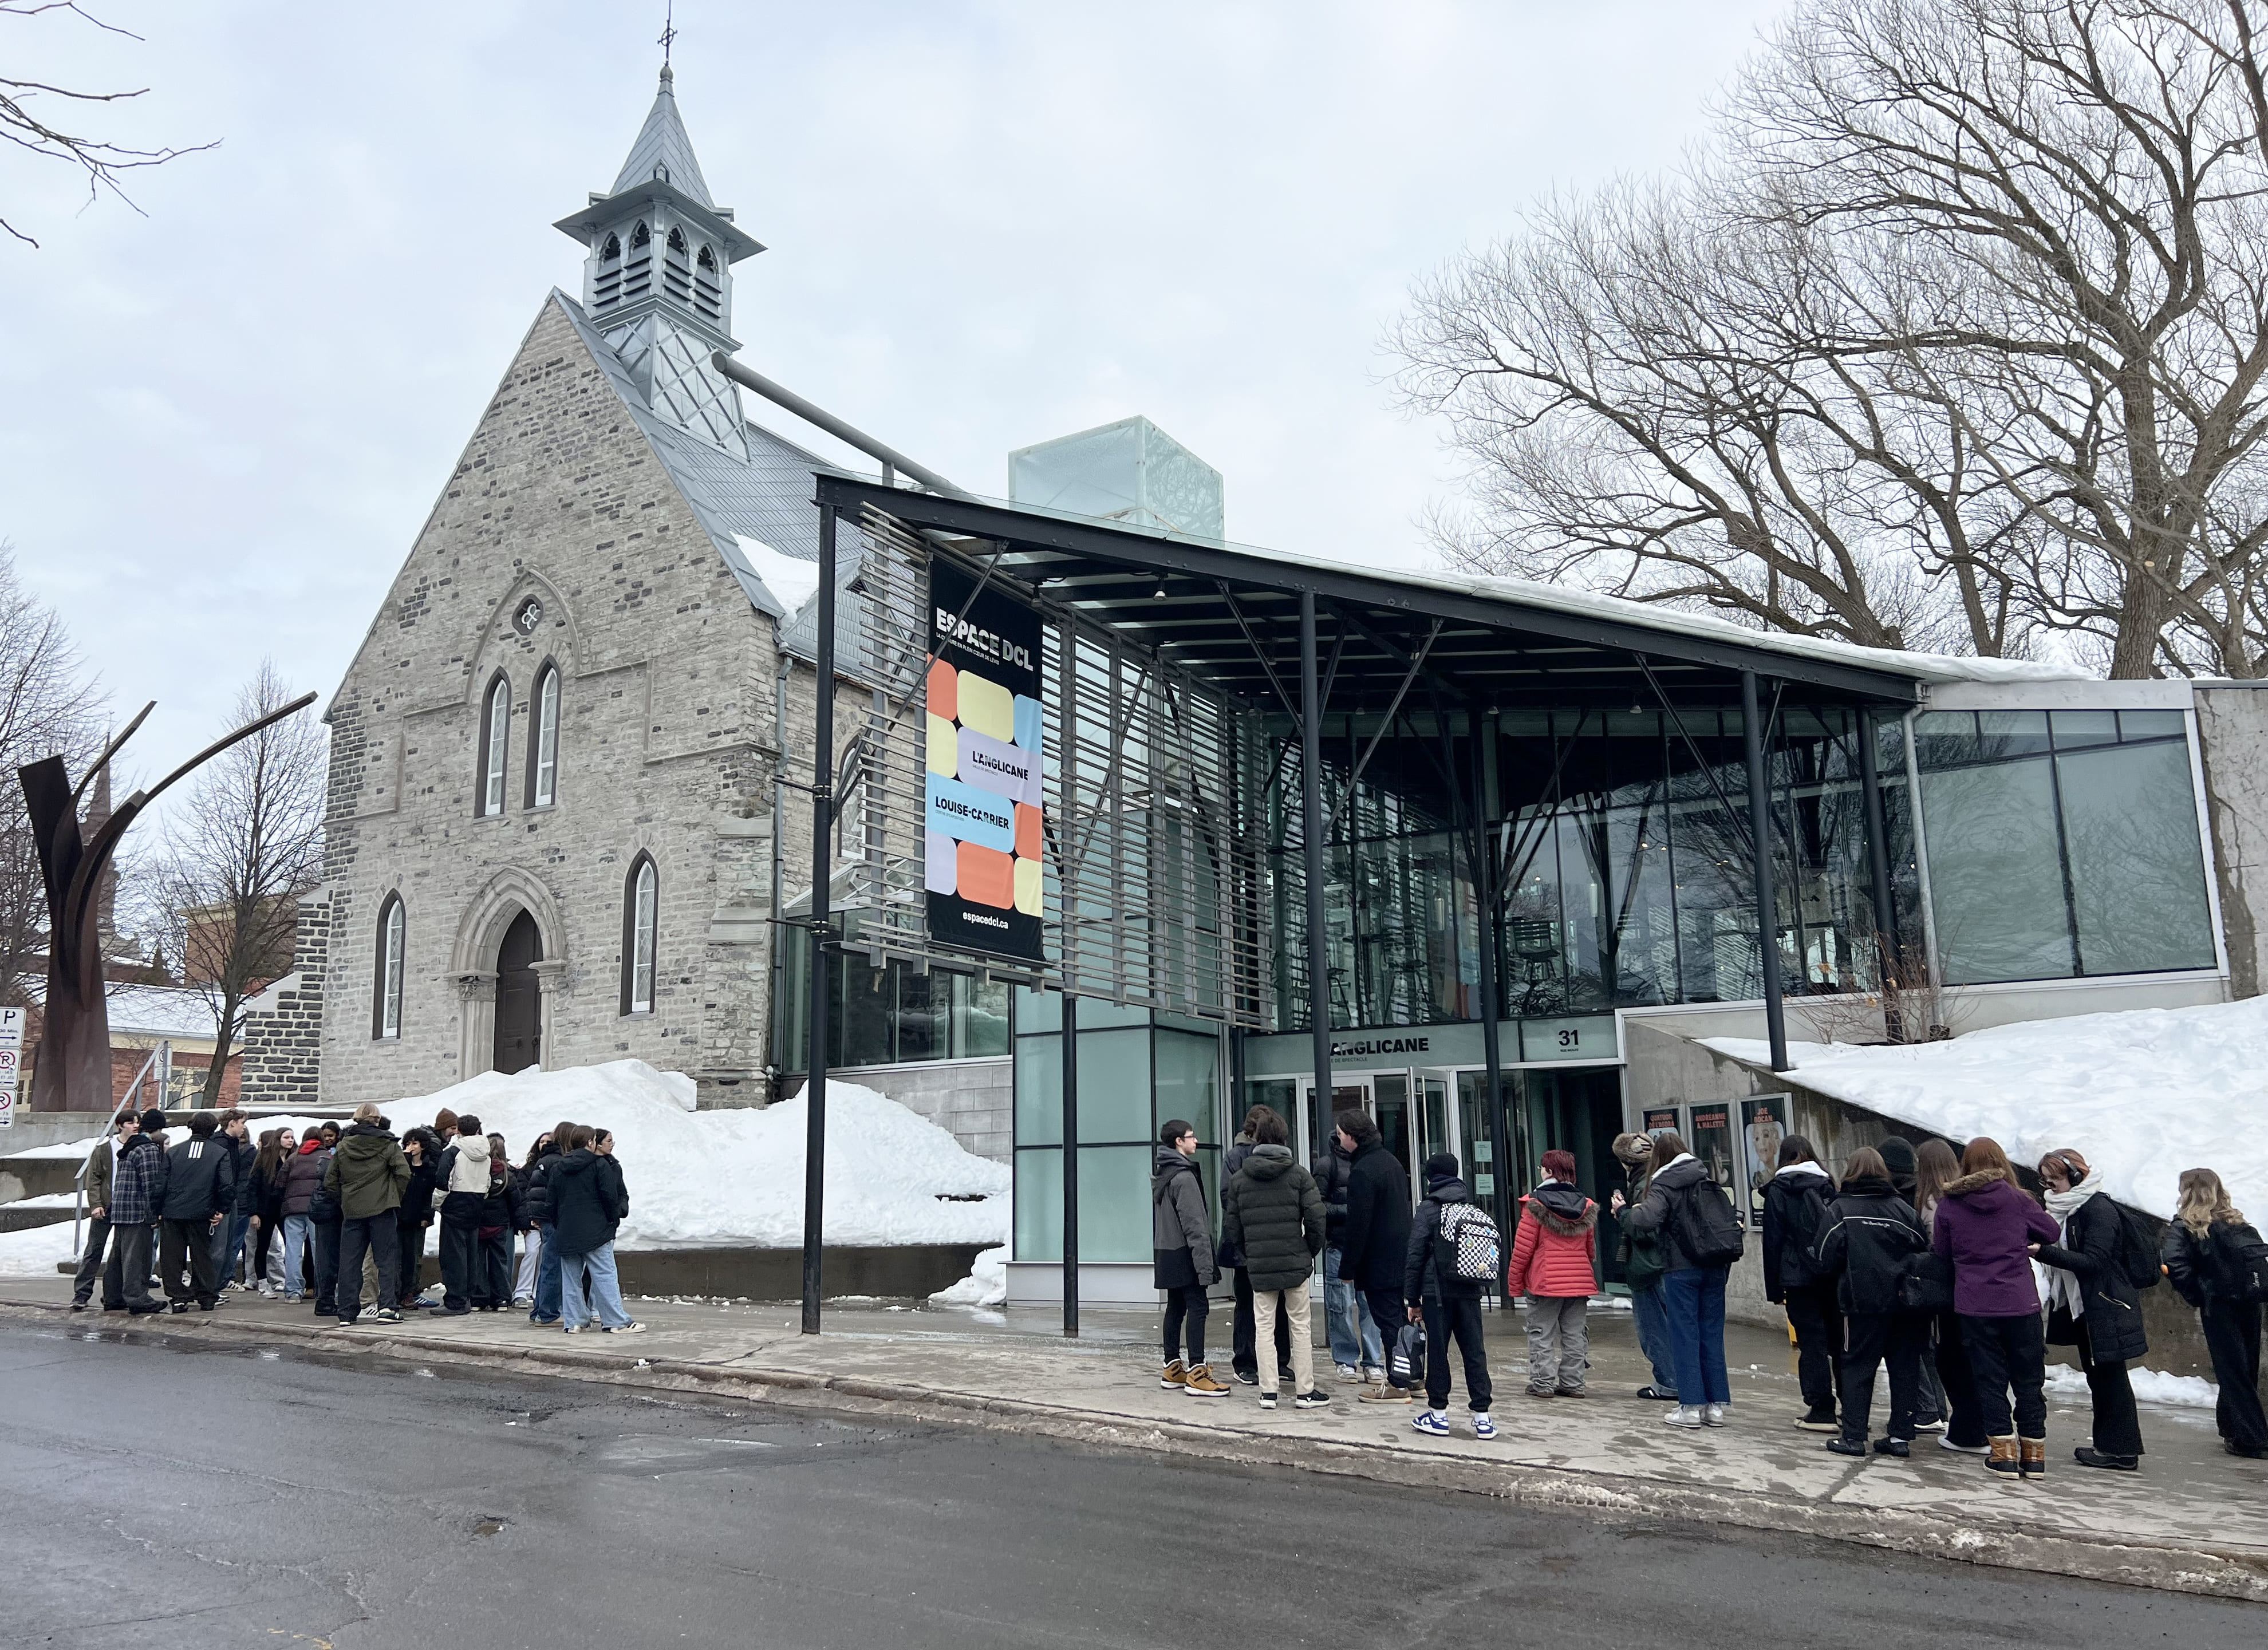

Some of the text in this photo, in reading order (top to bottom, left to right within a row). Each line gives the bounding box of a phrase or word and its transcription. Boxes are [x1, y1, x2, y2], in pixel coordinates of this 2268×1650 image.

[936, 607, 1034, 672] ESPACE DCL
[936, 796, 1009, 830] LOUISE-CARRIER
[963, 911, 1008, 929] espacedcl.ca
[1330, 1037, 1429, 1056] ANGLICANE
[1559, 1029, 1579, 1046] 31
[1757, 1107, 1768, 1115] JOE
